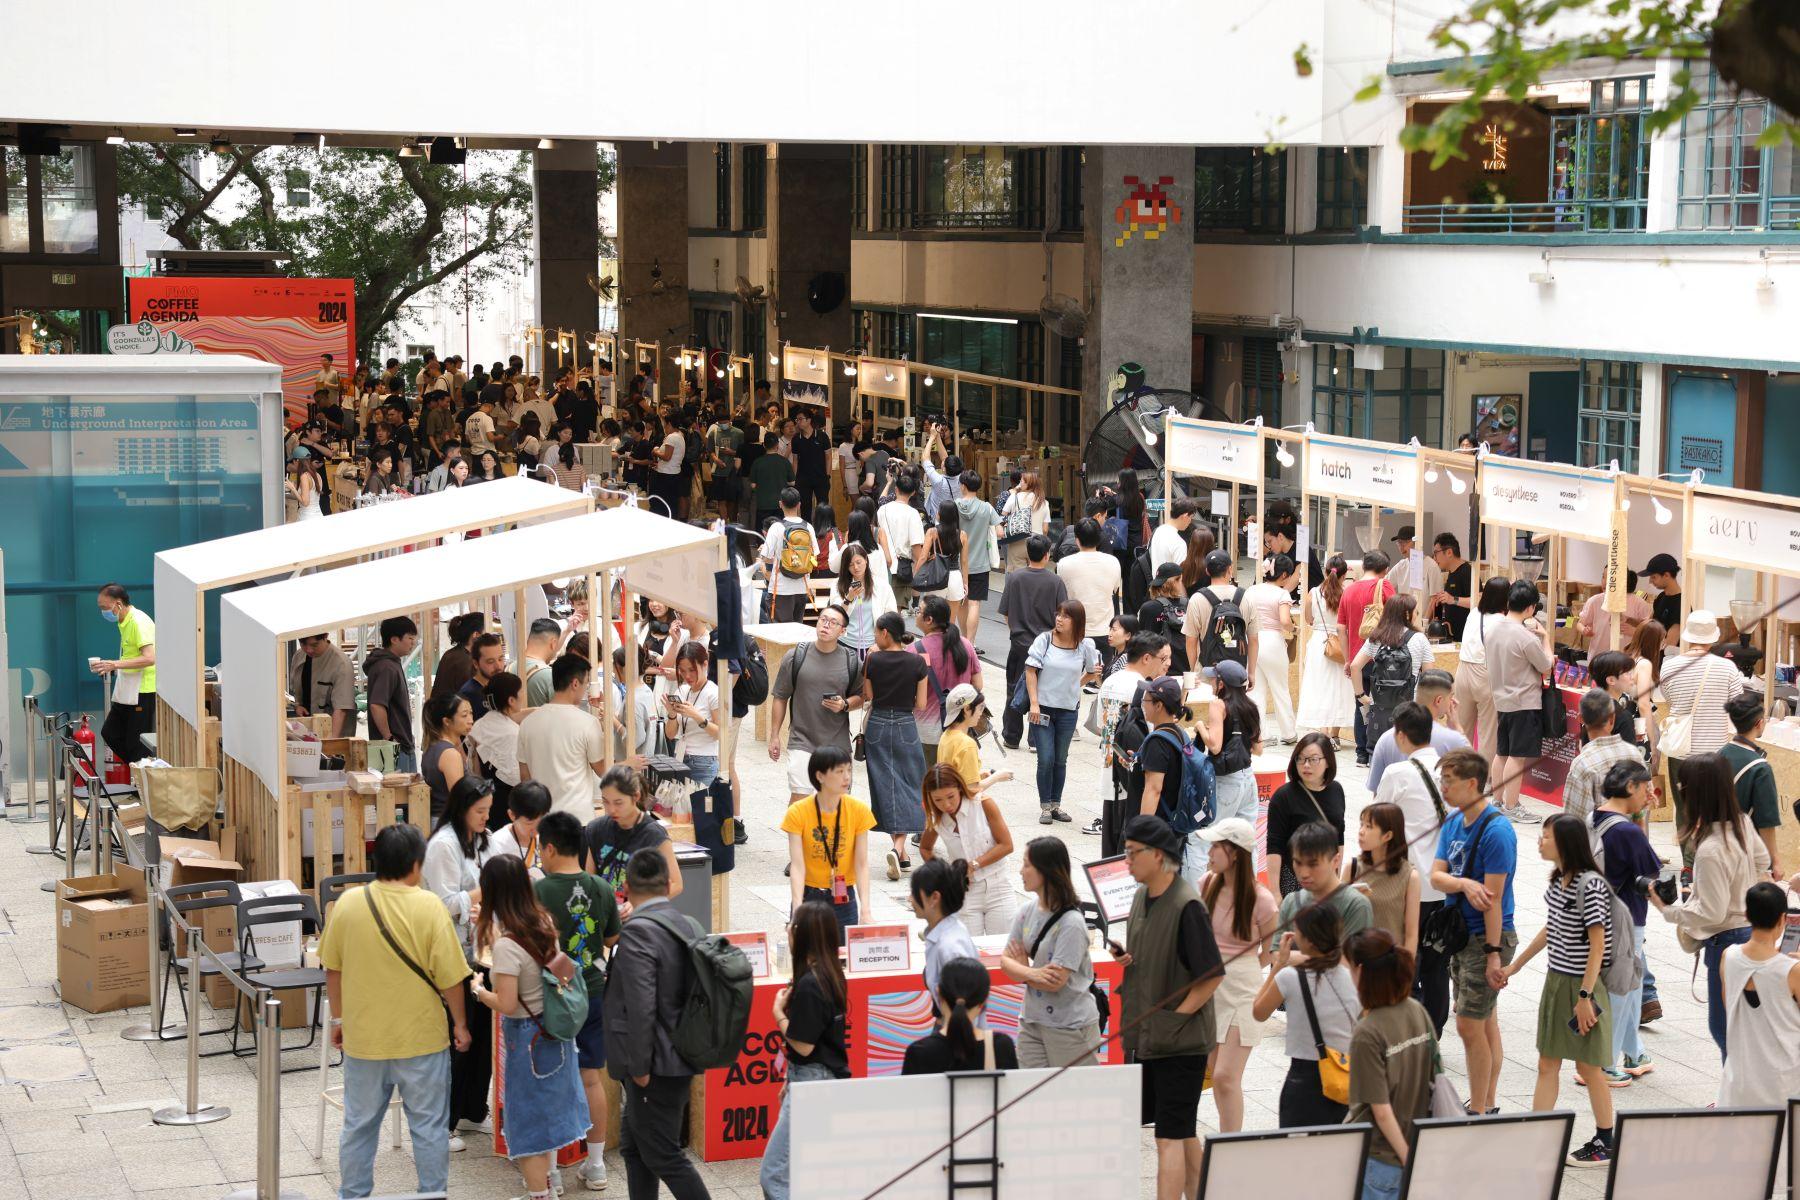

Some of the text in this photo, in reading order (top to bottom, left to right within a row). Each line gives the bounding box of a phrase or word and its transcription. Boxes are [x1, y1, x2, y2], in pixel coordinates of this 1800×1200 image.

[147, 299, 199, 310] COFFEE
[141, 311, 199, 322] AGENDA
[319, 302, 347, 323] 2024
[113, 336, 156, 345] GOONZILLA'S
[42, 418, 248, 430] Underground Interpretation Area
[1321, 459, 1352, 480] hatch
[722, 1105, 769, 1143] 2024
